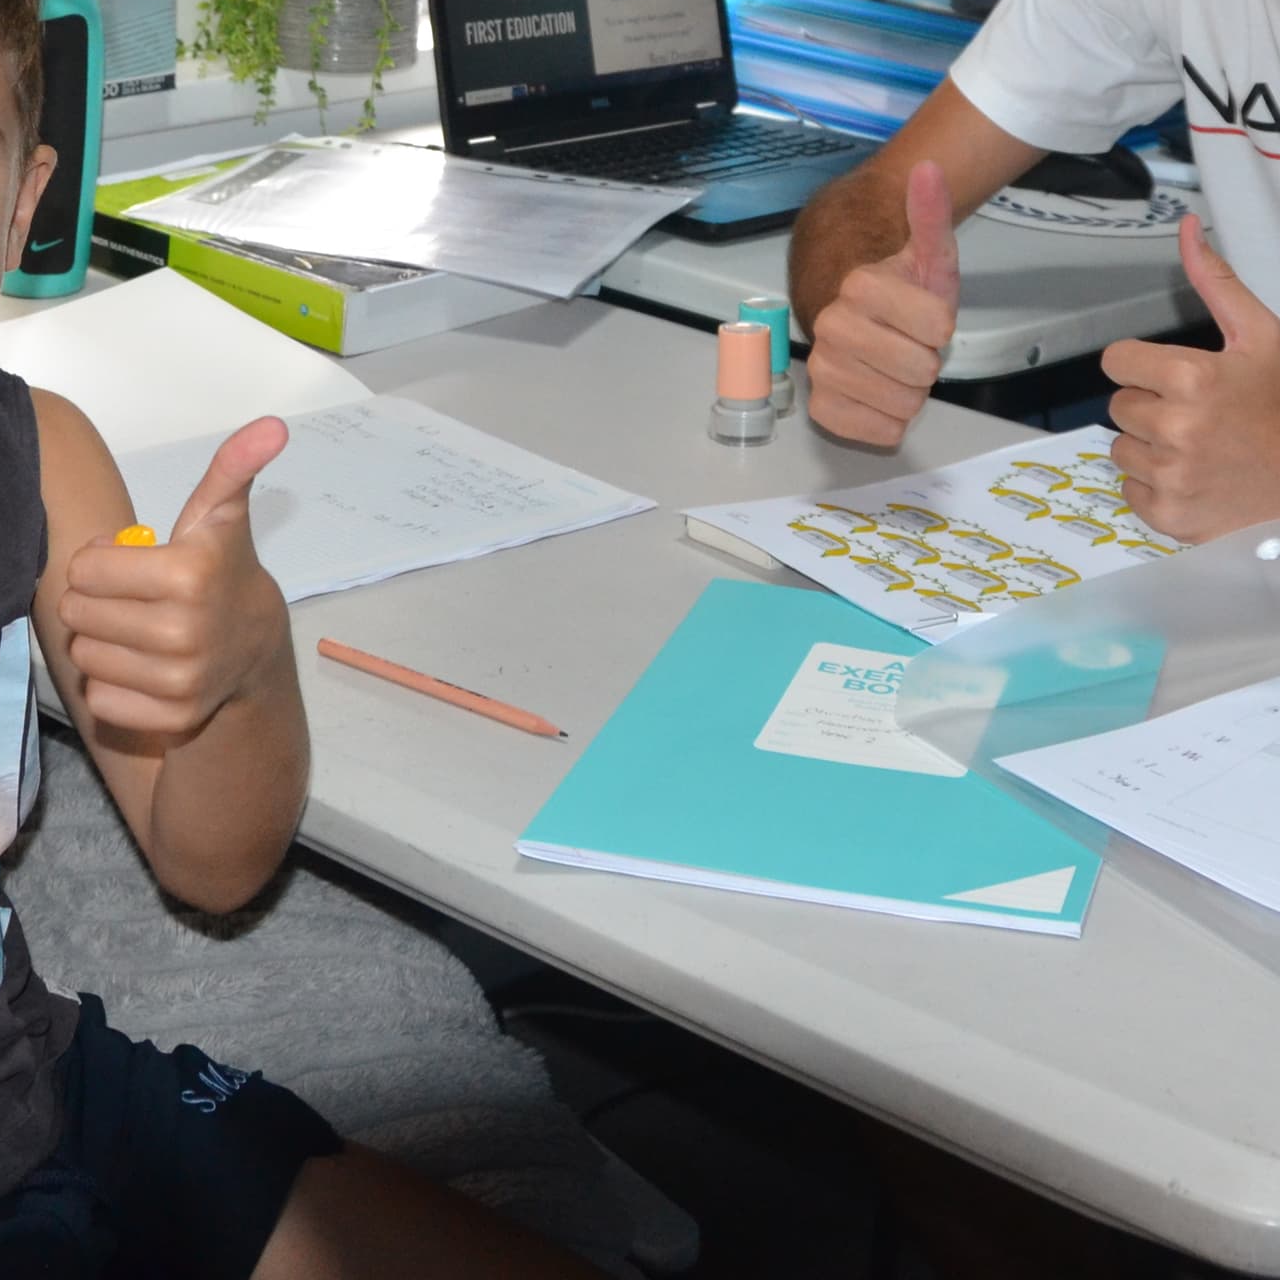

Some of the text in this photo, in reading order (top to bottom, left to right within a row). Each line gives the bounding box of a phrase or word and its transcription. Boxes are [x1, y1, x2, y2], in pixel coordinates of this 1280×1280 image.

[465, 20, 503, 46] FIRST
[507, 10, 577, 41] EDUCATION
[109, 241, 166, 267] MATHEMATICS
[883, 661, 905, 673] A
